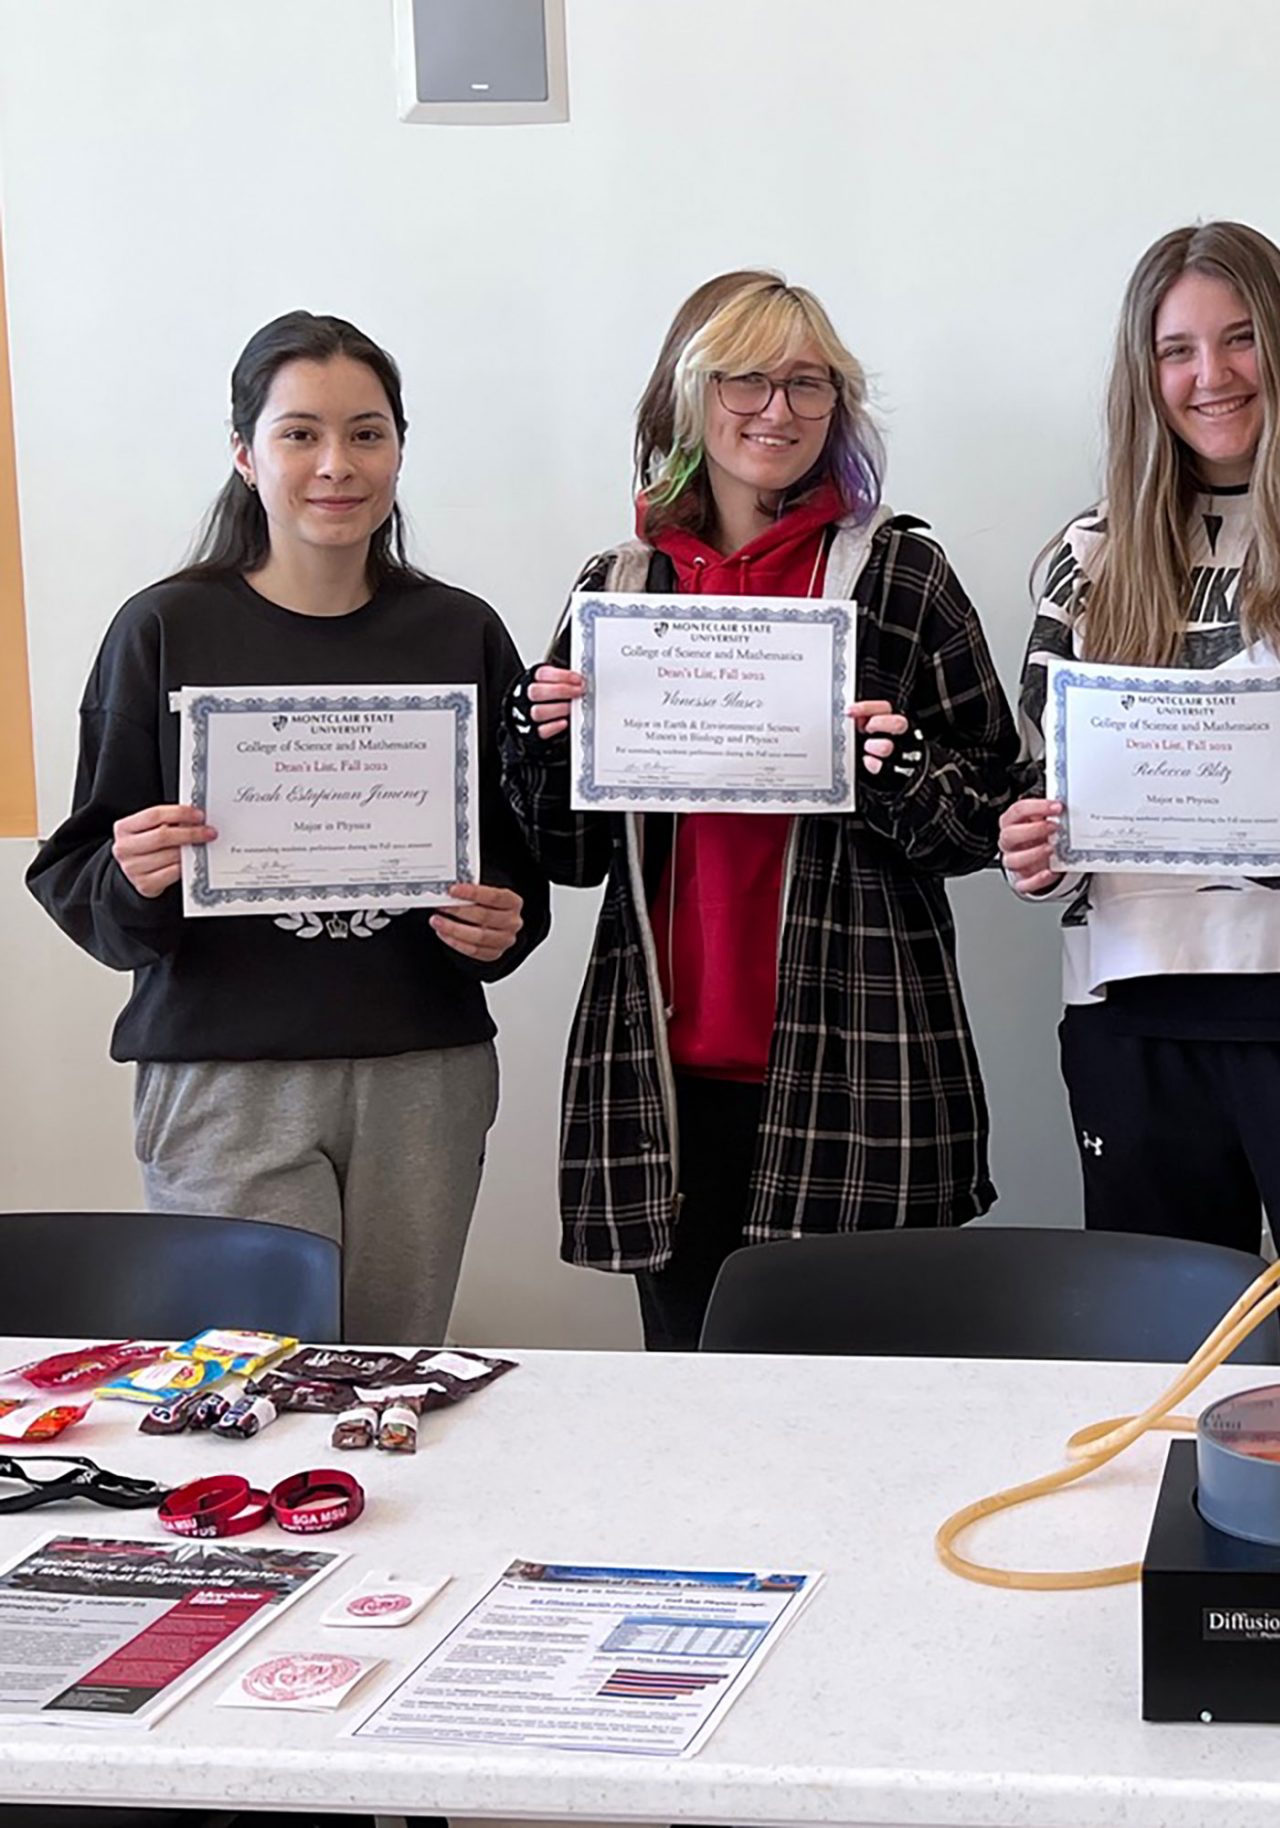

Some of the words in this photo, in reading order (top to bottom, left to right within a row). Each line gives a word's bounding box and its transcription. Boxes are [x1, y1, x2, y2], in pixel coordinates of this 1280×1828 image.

[672, 623, 738, 632] MONTCLAIR
[742, 624, 771, 633] STATE
[691, 634, 750, 643] UNIVERSITY
[621, 645, 659, 659] College
[662, 646, 672, 657] of
[675, 647, 711, 659] Science
[715, 648, 733, 659] and
[737, 649, 803, 661] Mathematics
[658, 667, 692, 679] Dean's
[719, 669, 738, 680] Fall
[1138, 696, 1203, 706] MONTCLAIR
[1206, 696, 1236, 705] STATE
[1157, 707, 1215, 716] UNIVERSITY
[291, 714, 360, 723] MONTCLAIR
[363, 713, 394, 723] STATE
[310, 725, 372, 734] UNIVERSITY
[624, 719, 650, 731] Major
[652, 721, 661, 729] in
[664, 720, 687, 729] Earth
[690, 721, 697, 730] &
[700, 721, 764, 731] Environmental
[767, 722, 800, 733] Science
[1090, 717, 1127, 731] College
[1129, 719, 1139, 730] of
[1142, 720, 1179, 731] Science
[1182, 721, 1200, 732] and
[1203, 721, 1270, 731] Mathematics
[679, 733, 688, 741] in
[690, 733, 724, 744] Biology
[727, 734, 743, 743] and
[745, 734, 779, 746] Physics
[1126, 739, 1159, 750] Dean's
[1187, 740, 1207, 751] Fall
[237, 741, 277, 755] College
[280, 741, 291, 751] of
[294, 740, 332, 751] Science
[336, 740, 355, 750] and
[359, 739, 427, 750] Mathematics
[275, 761, 311, 772] Dean's
[341, 761, 360, 771] Fall
[235, 784, 282, 803] Sarah
[1146, 795, 1173, 806] Major
[1186, 795, 1219, 806] Physics
[294, 821, 321, 833] Major
[325, 822, 334, 830] in
[337, 821, 371, 832] Physics
[292, 1514, 319, 1525] SGA
[321, 1506, 347, 1522] MSU
[39, 1567, 132, 1583] Mechanical
[135, 1573, 234, 1586] Engineering
[140, 1566, 207, 1578] Physics
